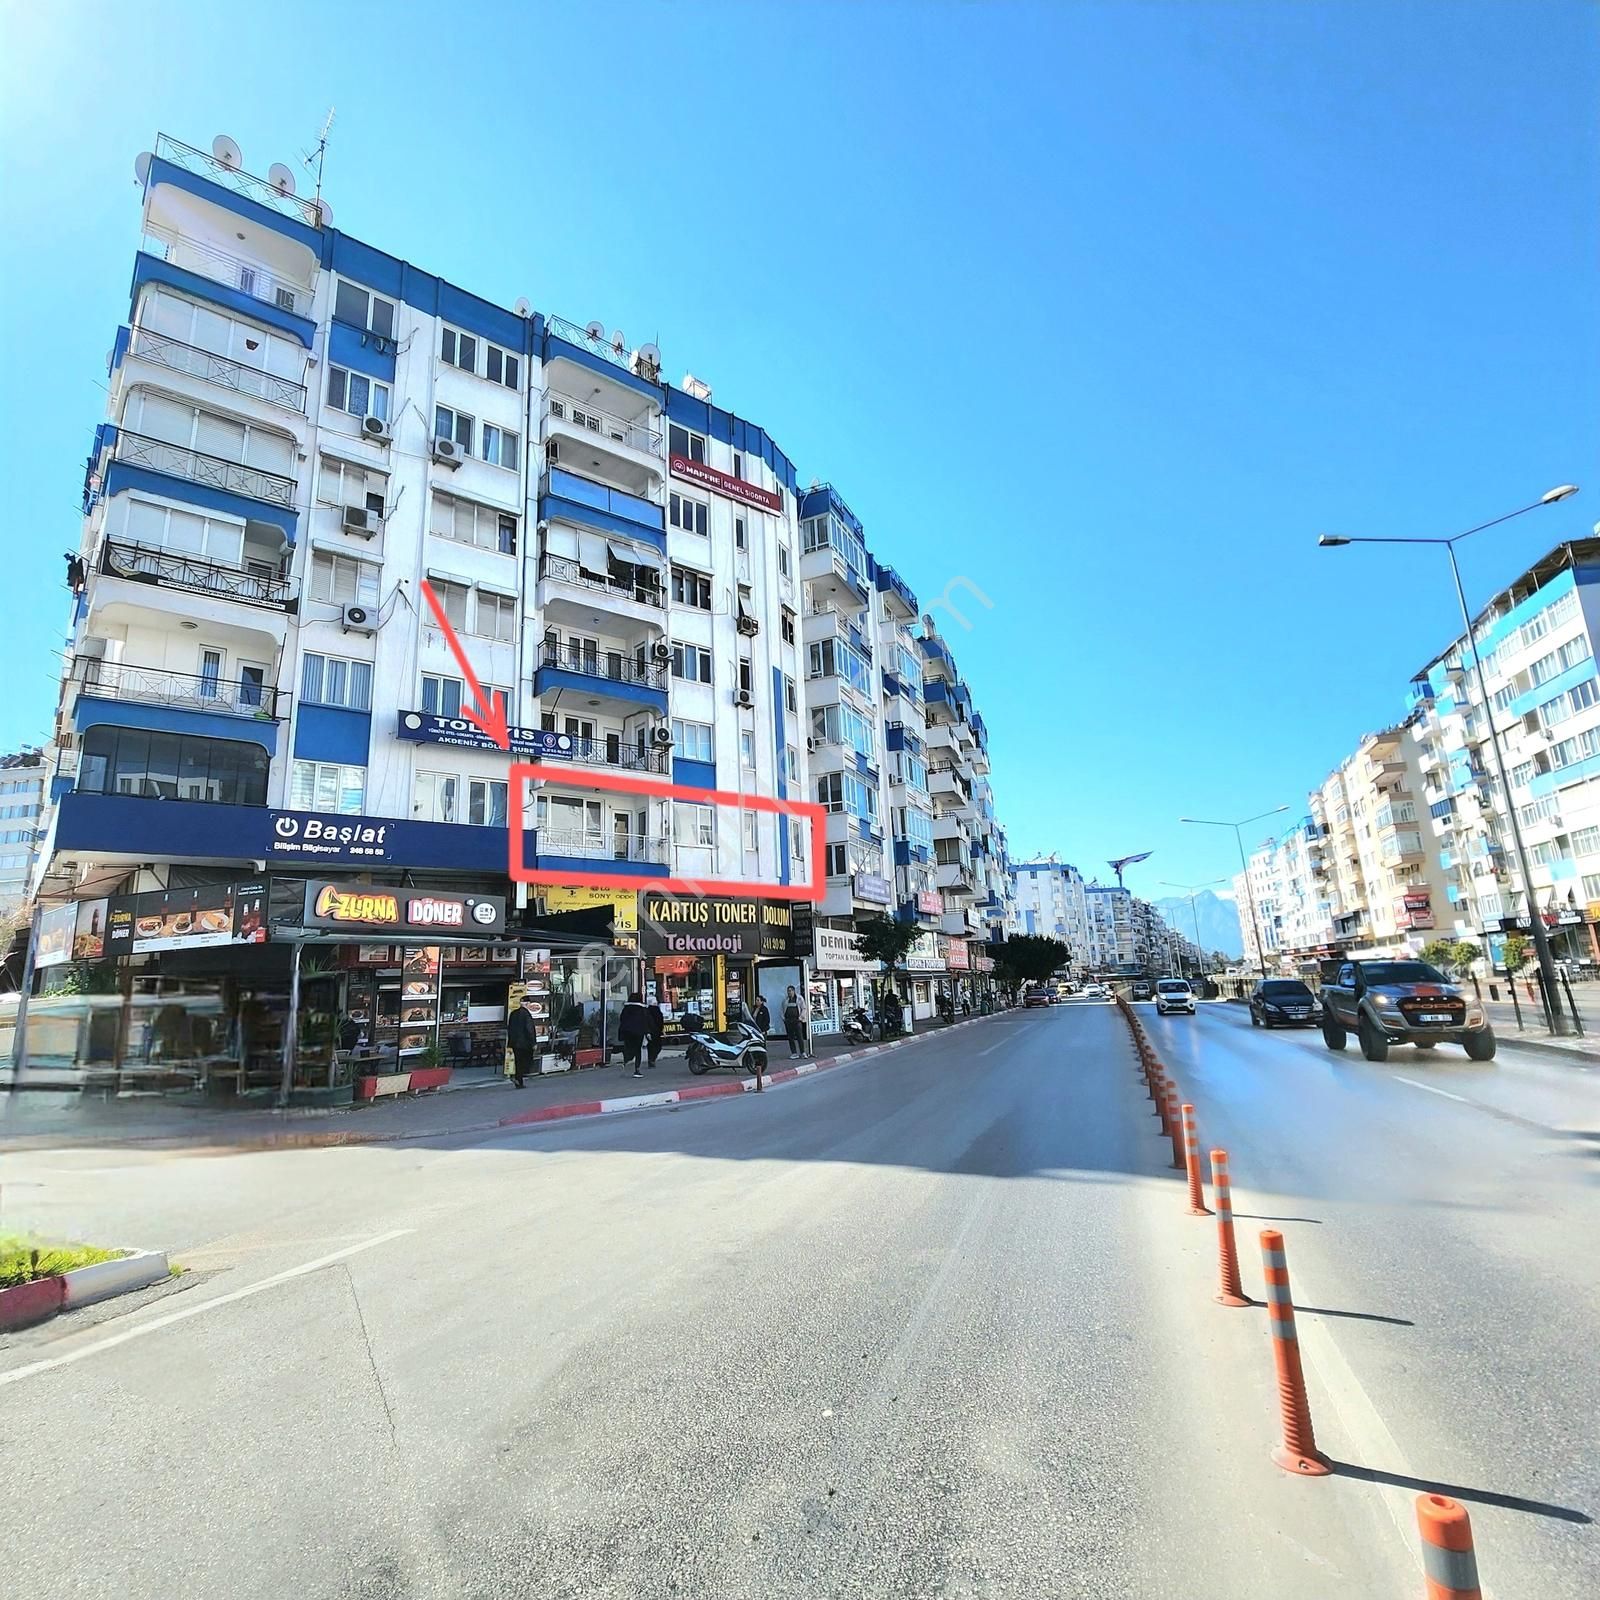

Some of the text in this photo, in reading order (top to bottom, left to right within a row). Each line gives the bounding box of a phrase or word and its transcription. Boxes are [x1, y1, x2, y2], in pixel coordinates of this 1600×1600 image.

[686, 466, 720, 485] MAPFRE
[723, 481, 744, 495] GENEL
[438, 736, 479, 747] AKDENİZ
[512, 746, 535, 754] ŞUBE
[303, 820, 386, 844] Başlat
[302, 843, 342, 854] Bilgisayar
[337, 893, 398, 922] ZURNA
[411, 898, 463, 924] DÖNER
[649, 901, 709, 927] KARTUŞ
[713, 902, 757, 923] TONER
[762, 905, 790, 926] DOLUM
[664, 932, 742, 953] Teknoloji
[825, 953, 845, 961] TOPTAN
